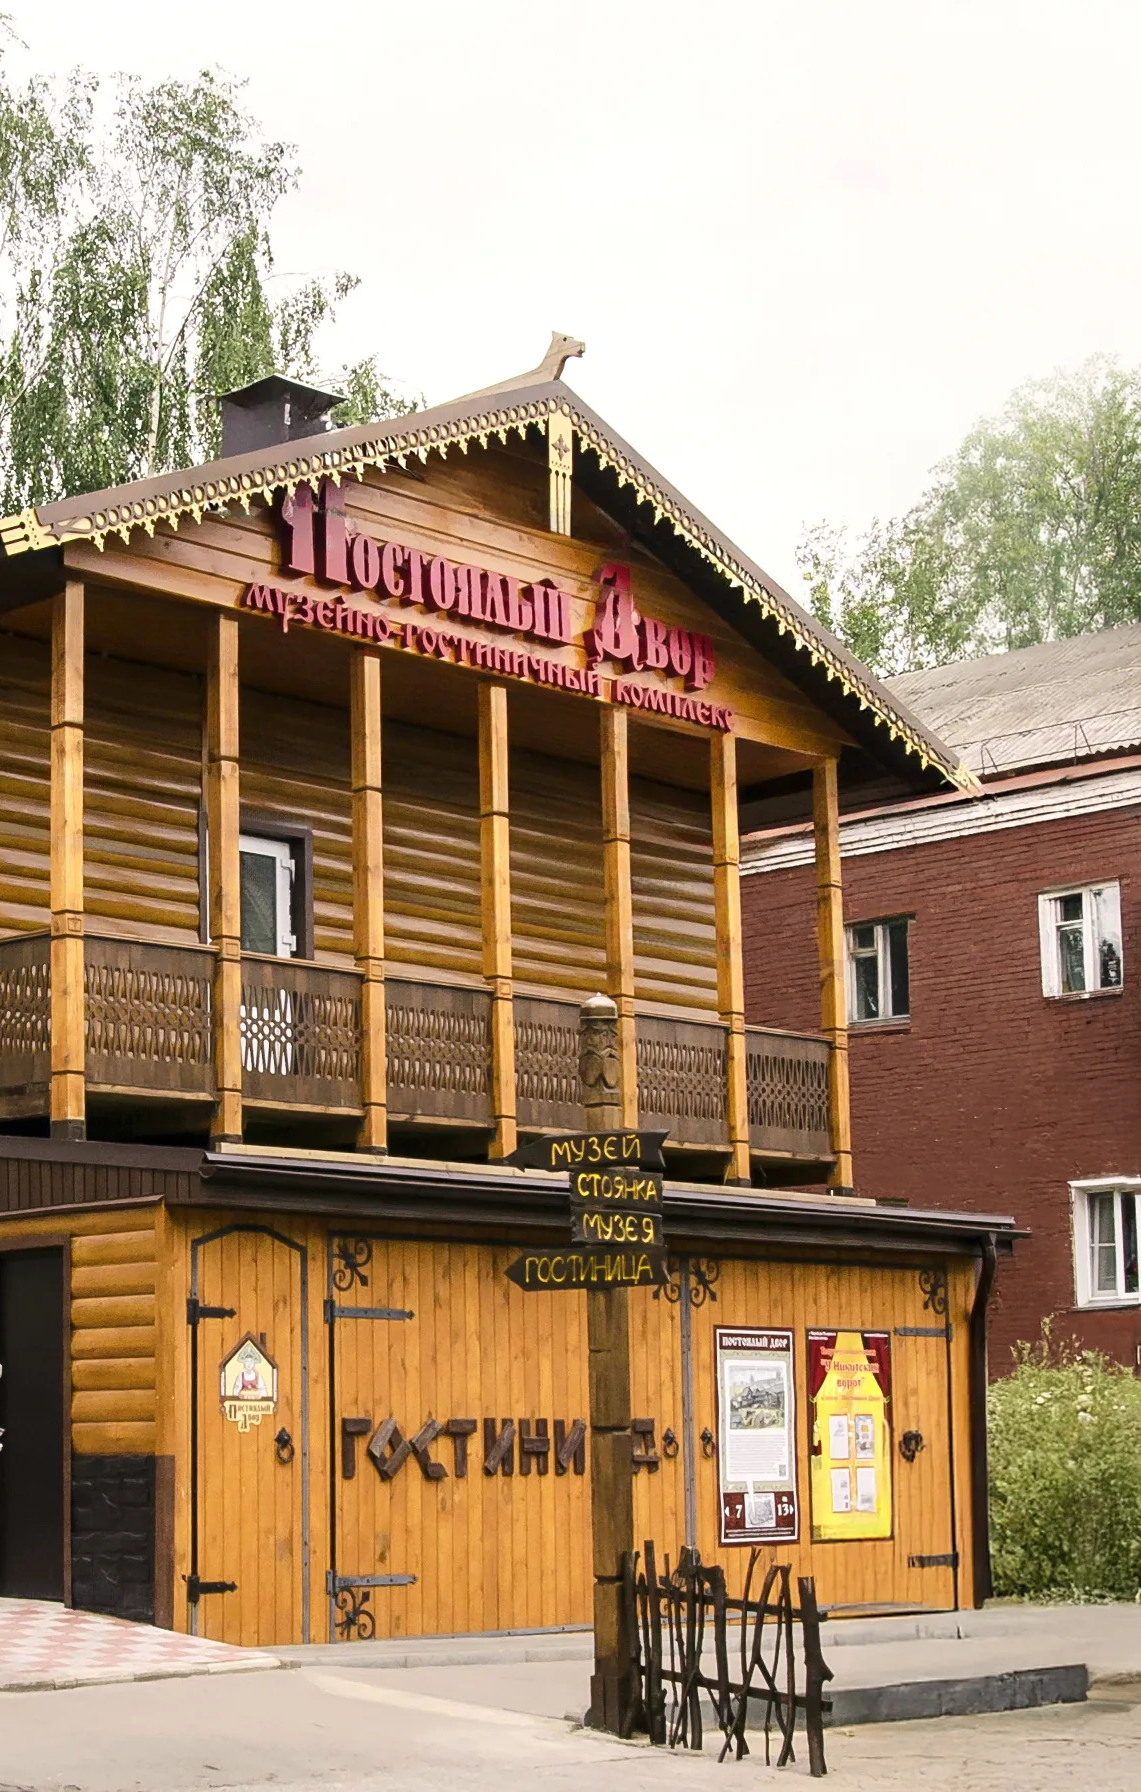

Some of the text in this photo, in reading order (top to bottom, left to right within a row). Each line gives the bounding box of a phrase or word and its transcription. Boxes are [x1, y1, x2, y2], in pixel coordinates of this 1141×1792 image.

[551, 1134, 641, 1166] МУЗЕЙ
[577, 1173, 658, 1201] СТОЯНКА
[582, 1213, 655, 1244] МУЗЕЯ
[525, 1254, 654, 1285] ГОСТИНИЦА
[342, 1415, 660, 1481] ГОСТИНИА
[735, 1504, 743, 1519] 7
